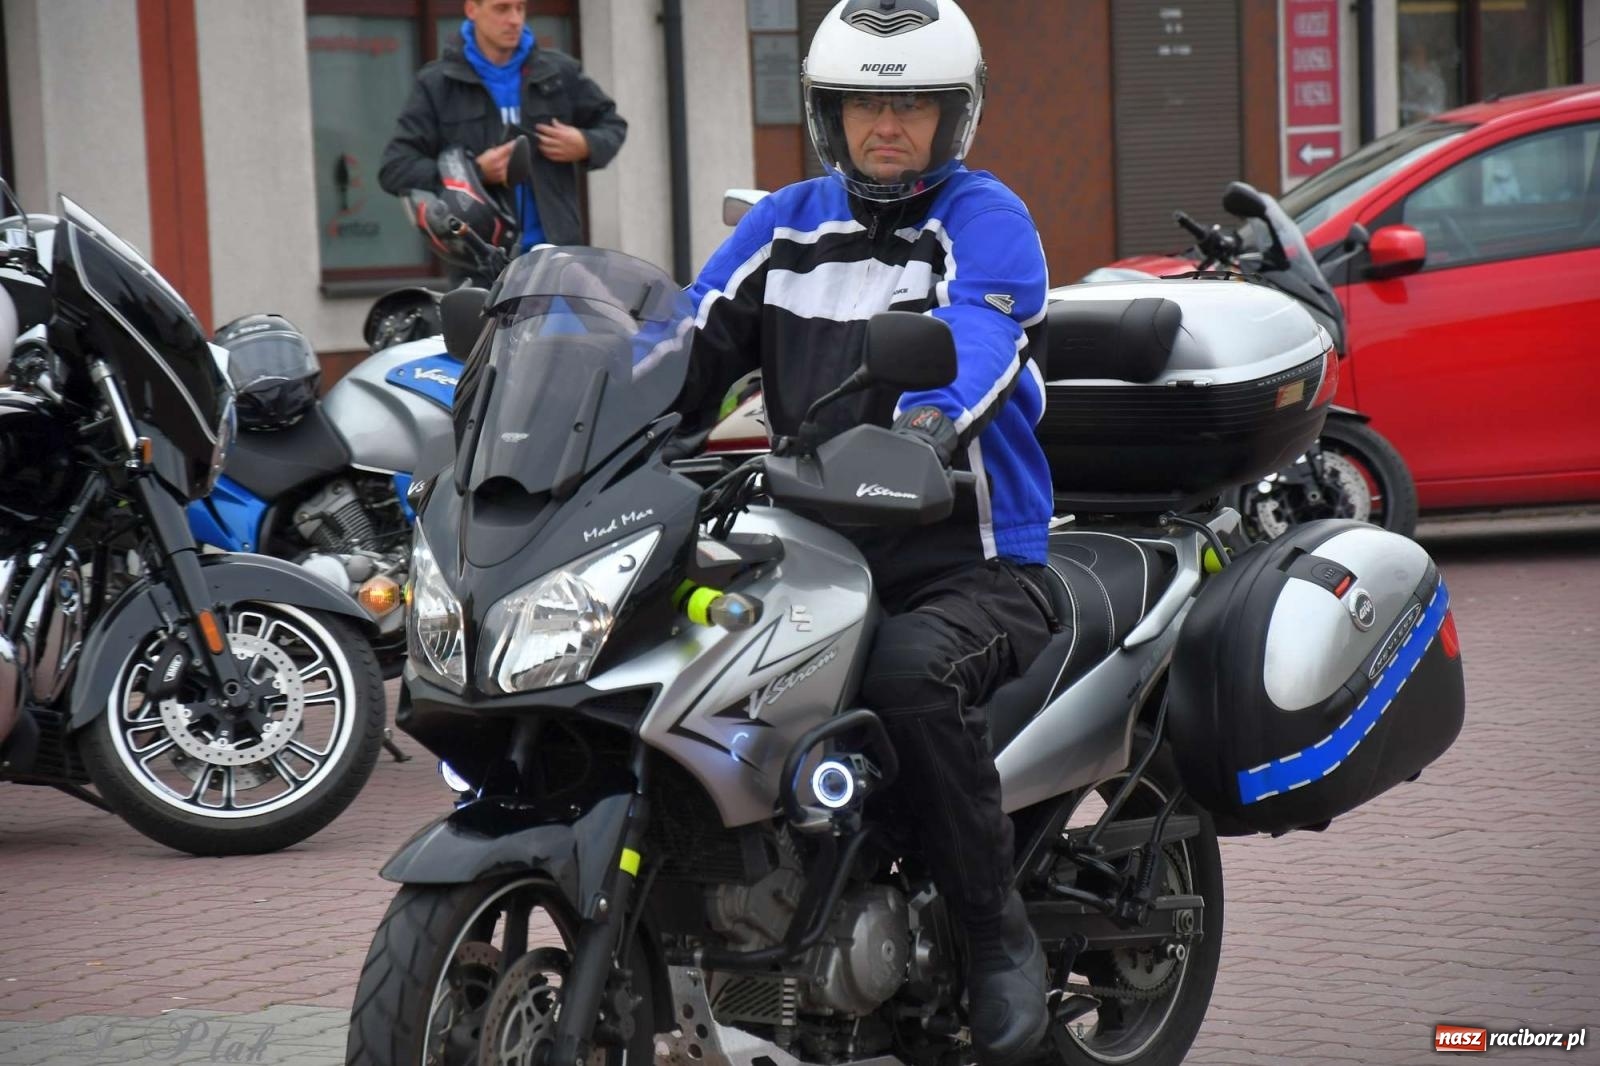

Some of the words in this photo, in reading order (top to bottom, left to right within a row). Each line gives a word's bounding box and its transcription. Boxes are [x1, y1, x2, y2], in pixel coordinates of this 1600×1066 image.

[860, 63, 907, 76] NOLAN
[583, 519, 618, 542] Mad
[620, 508, 654, 526] Max
